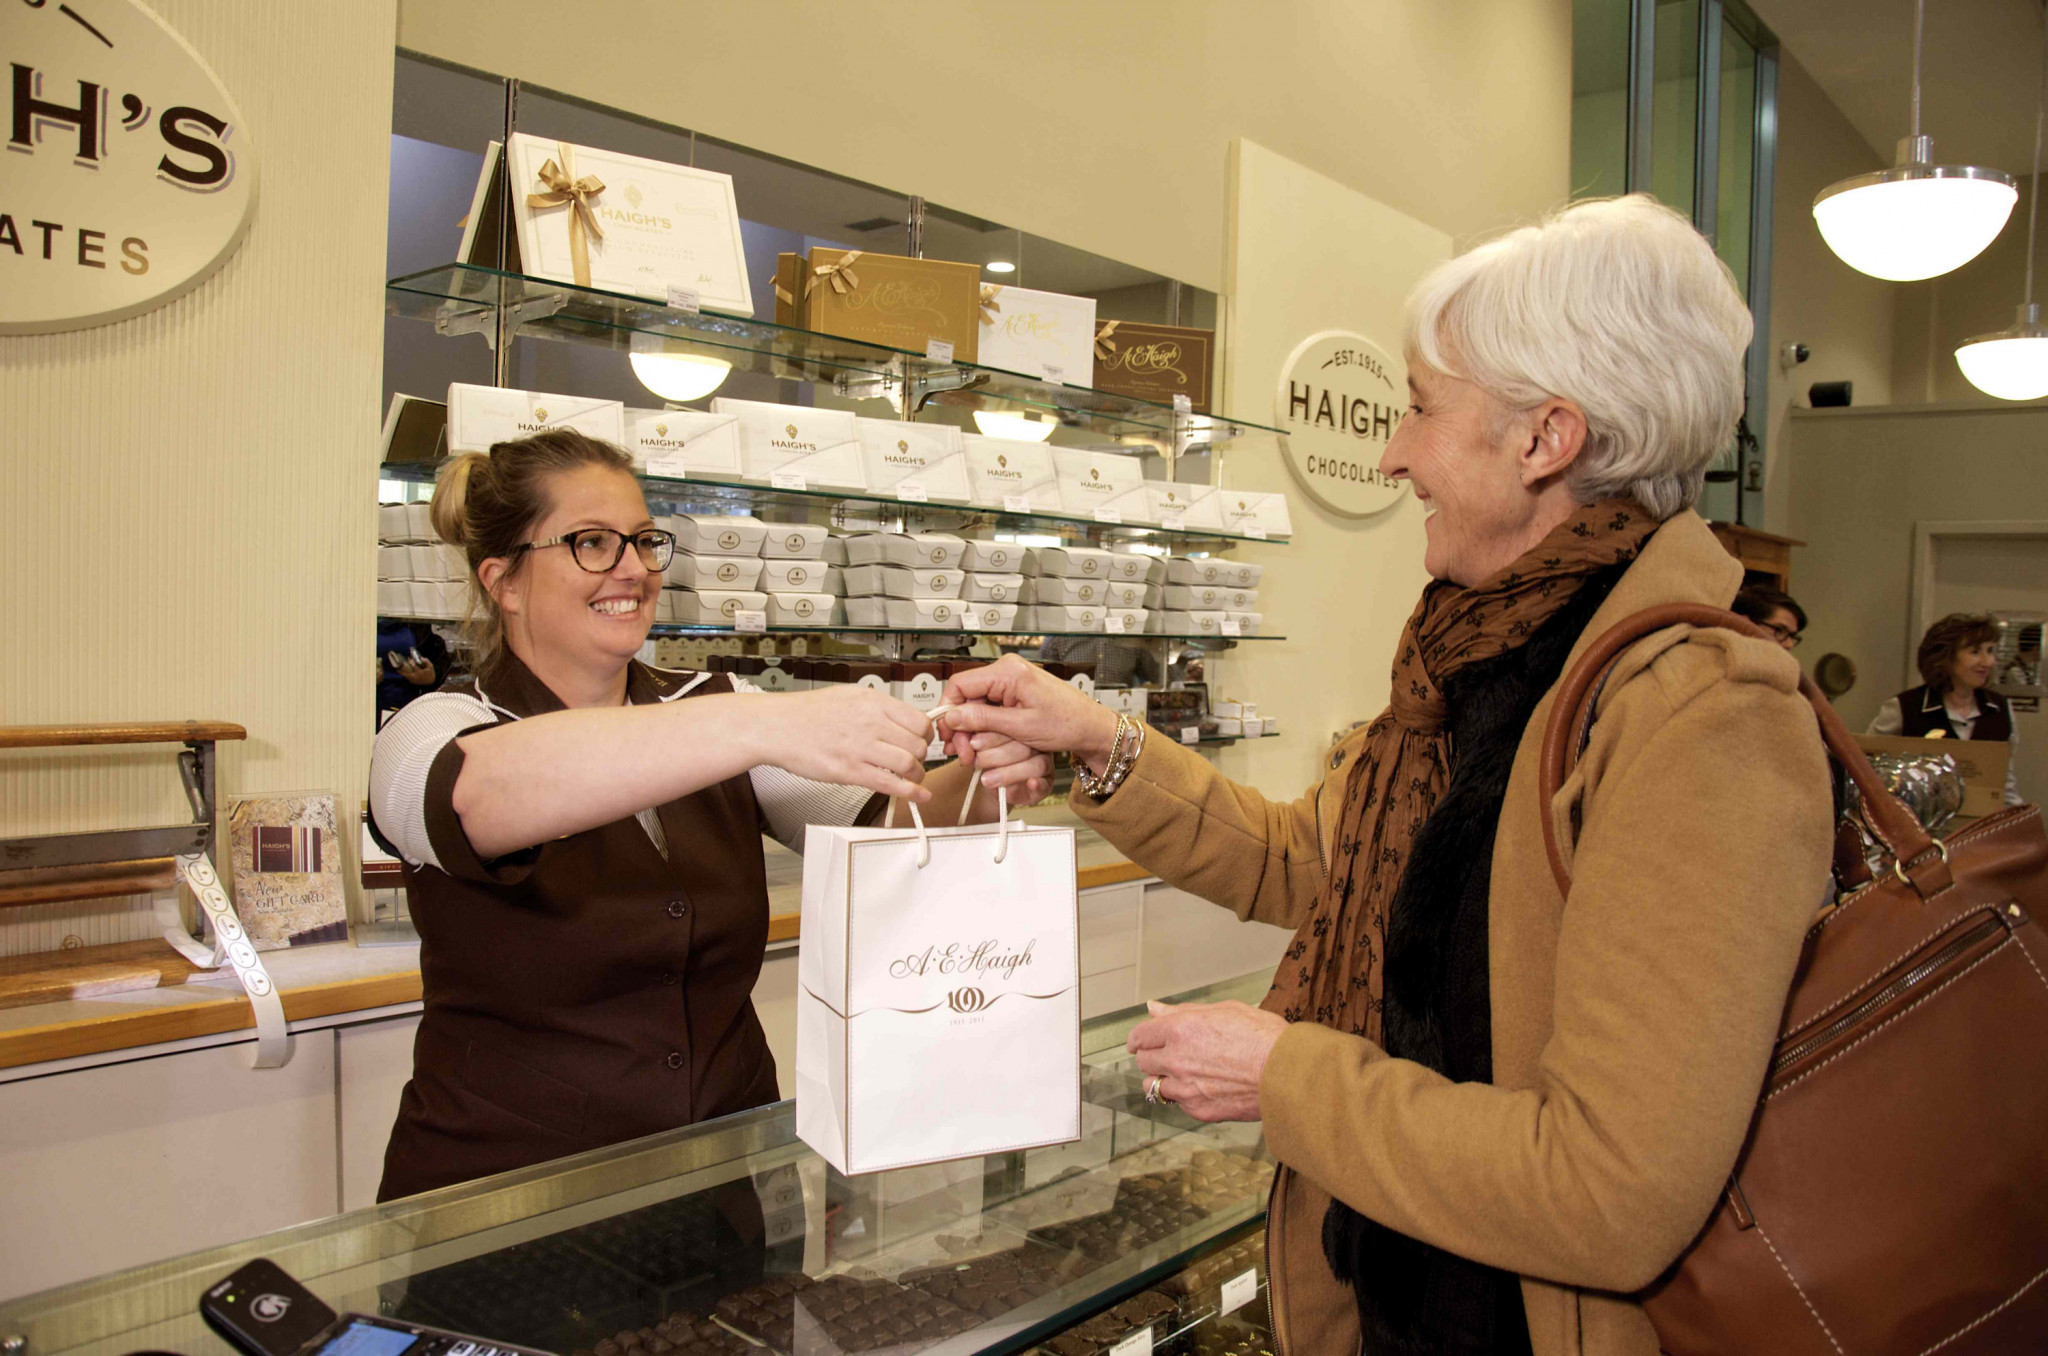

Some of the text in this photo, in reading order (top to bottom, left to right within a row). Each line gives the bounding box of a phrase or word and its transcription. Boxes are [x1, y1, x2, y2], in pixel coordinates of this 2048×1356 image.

[600, 207, 673, 230] HAIGH'S
[1289, 380, 1407, 443] HAIGH'
[640, 438, 685, 448] HAIGH'S
[771, 440, 816, 451] HAIGH'S
[884, 455, 925, 466] HAIGH'S
[987, 469, 1022, 479] HAIGH'S
[1080, 481, 1113, 491] HAIGH'S
[256, 893, 325, 908] GIFT CARD
